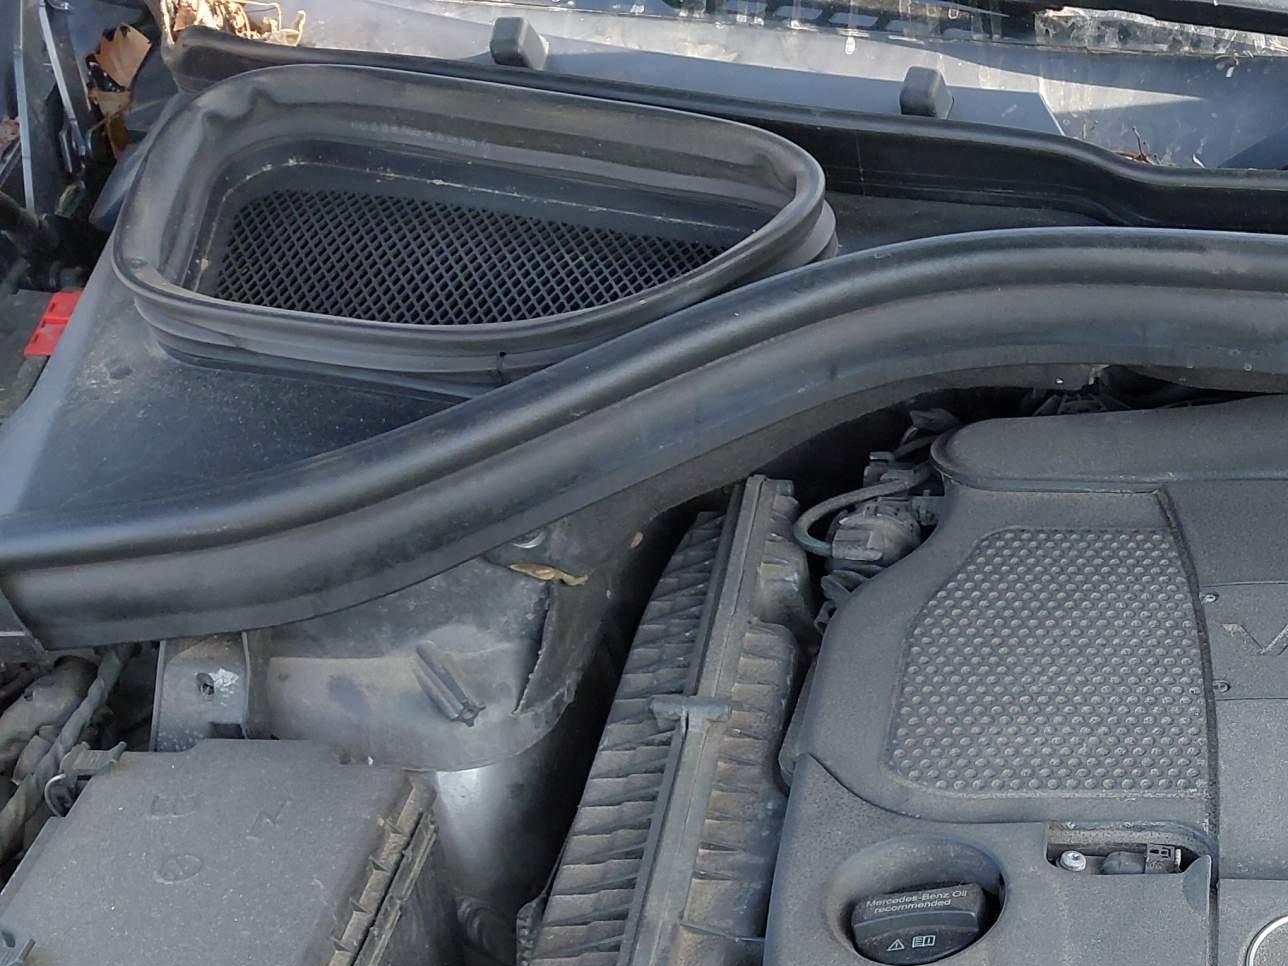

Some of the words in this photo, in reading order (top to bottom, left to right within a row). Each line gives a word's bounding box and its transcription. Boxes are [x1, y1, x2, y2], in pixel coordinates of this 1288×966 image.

[865, 892, 950, 908] Mercedes-Benz
[951, 890, 968, 899] Oil
[873, 898, 952, 914] recommended
